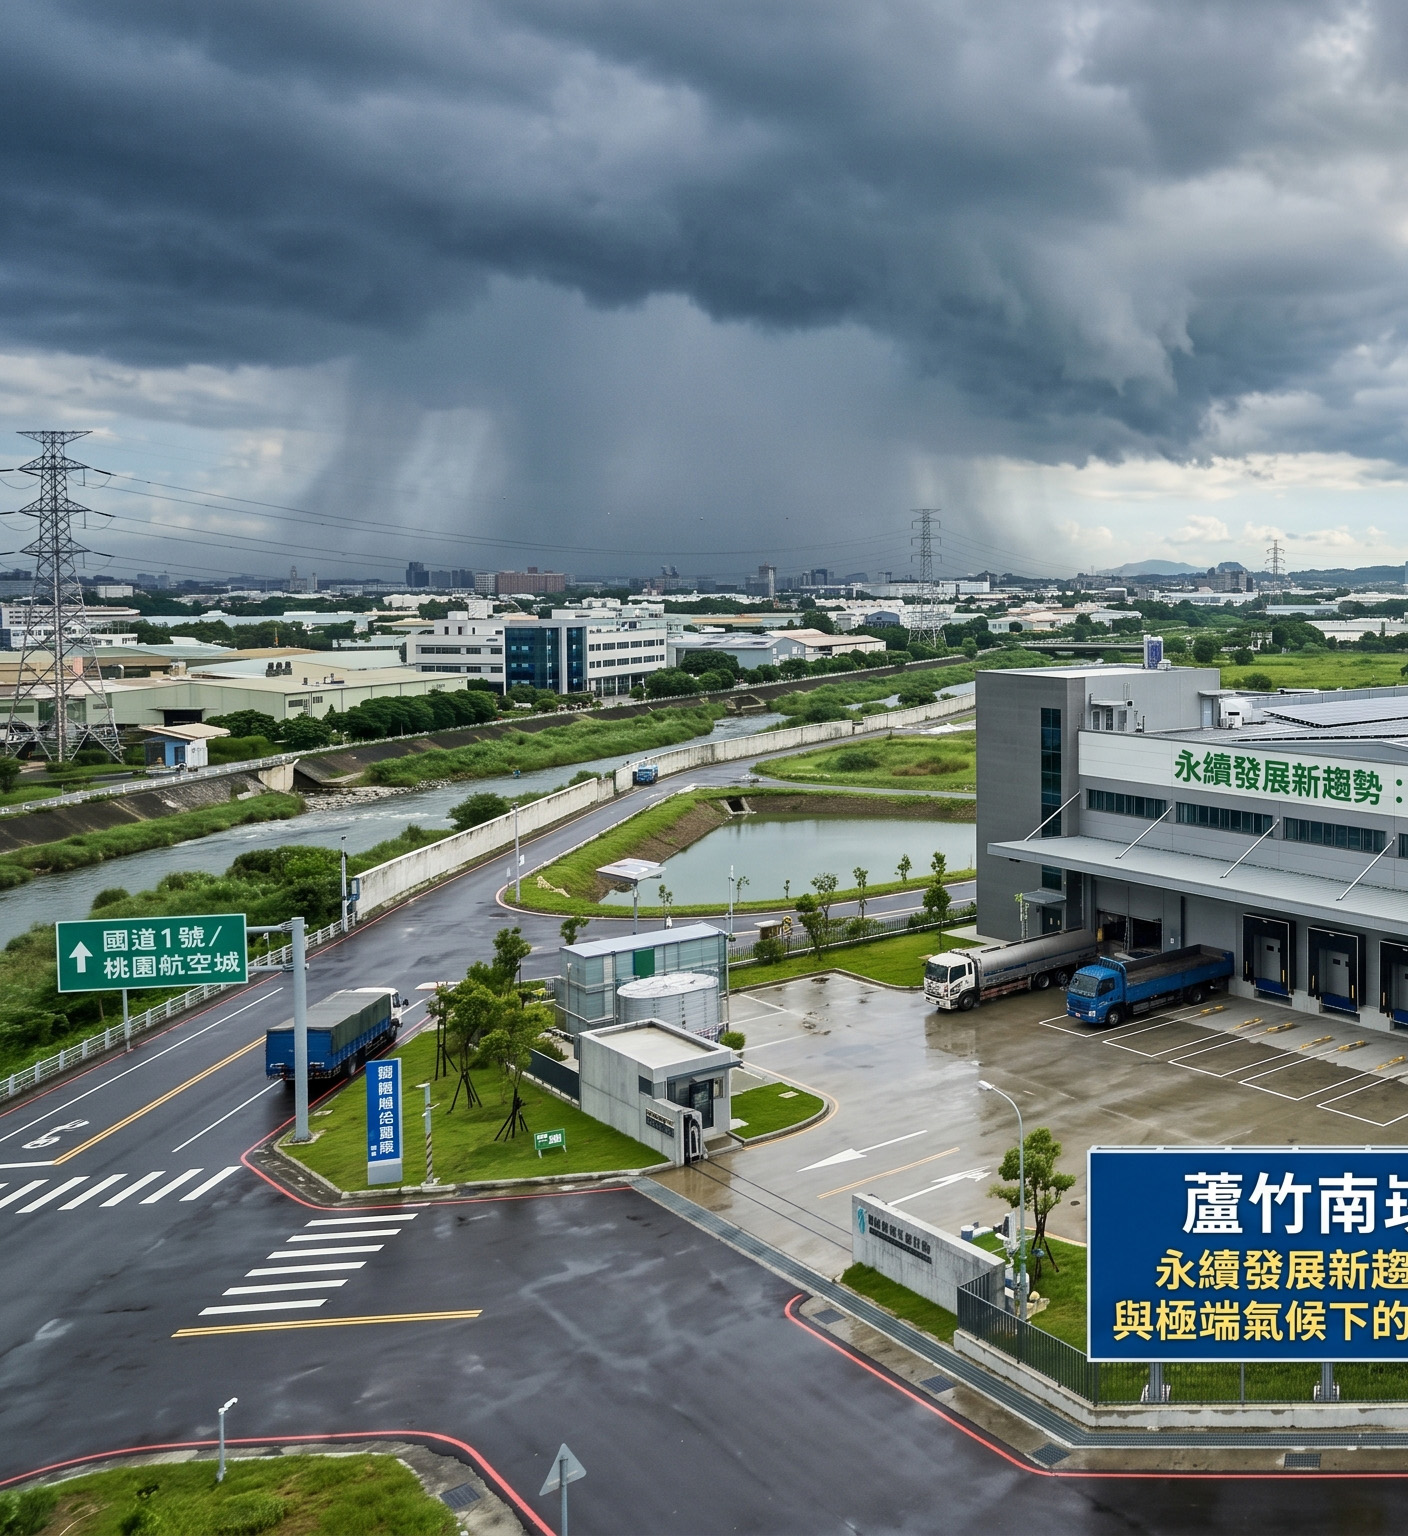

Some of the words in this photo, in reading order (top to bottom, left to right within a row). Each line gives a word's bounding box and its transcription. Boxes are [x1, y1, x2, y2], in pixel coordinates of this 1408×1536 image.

[103, 925, 222, 952] 國道1號/
[104, 951, 241, 979] 桃園航空城
